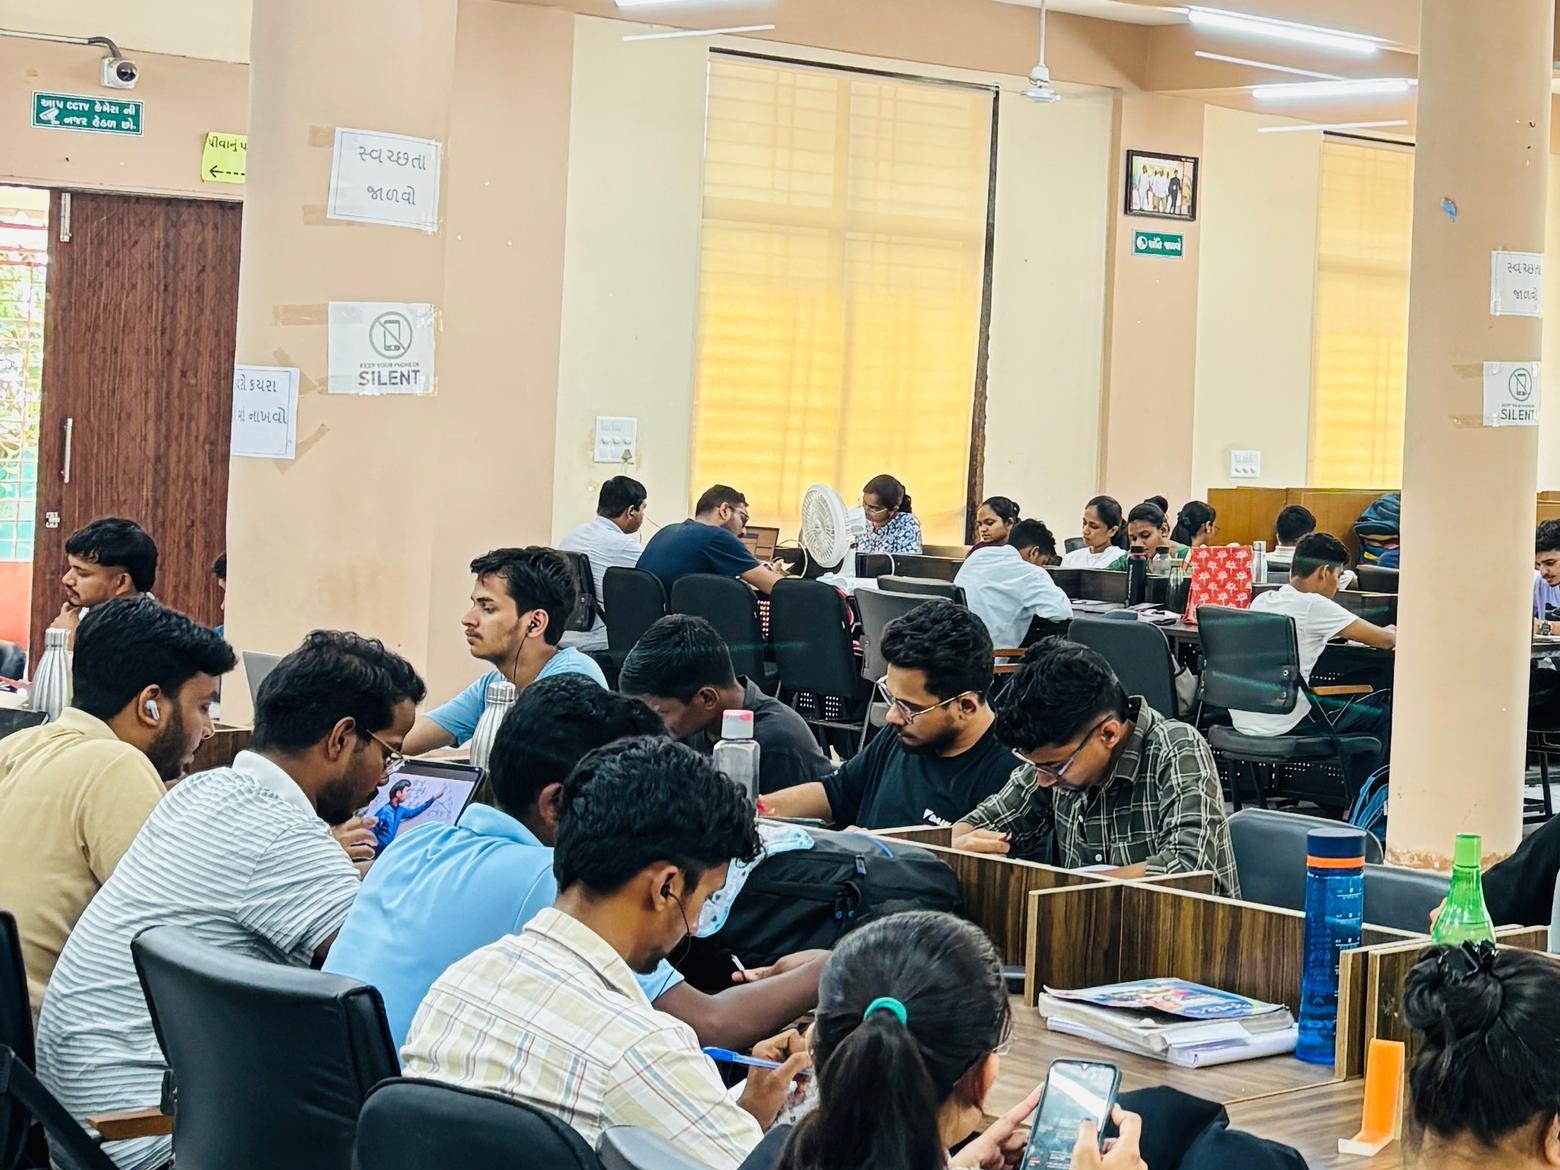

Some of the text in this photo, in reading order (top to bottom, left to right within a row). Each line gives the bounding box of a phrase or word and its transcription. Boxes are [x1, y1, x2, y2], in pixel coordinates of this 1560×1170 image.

[66, 101, 90, 111] CCTV
[367, 185, 416, 205] જાળવો
[358, 369, 421, 386] SILENT
[1500, 408, 1535, 421] SILENT
